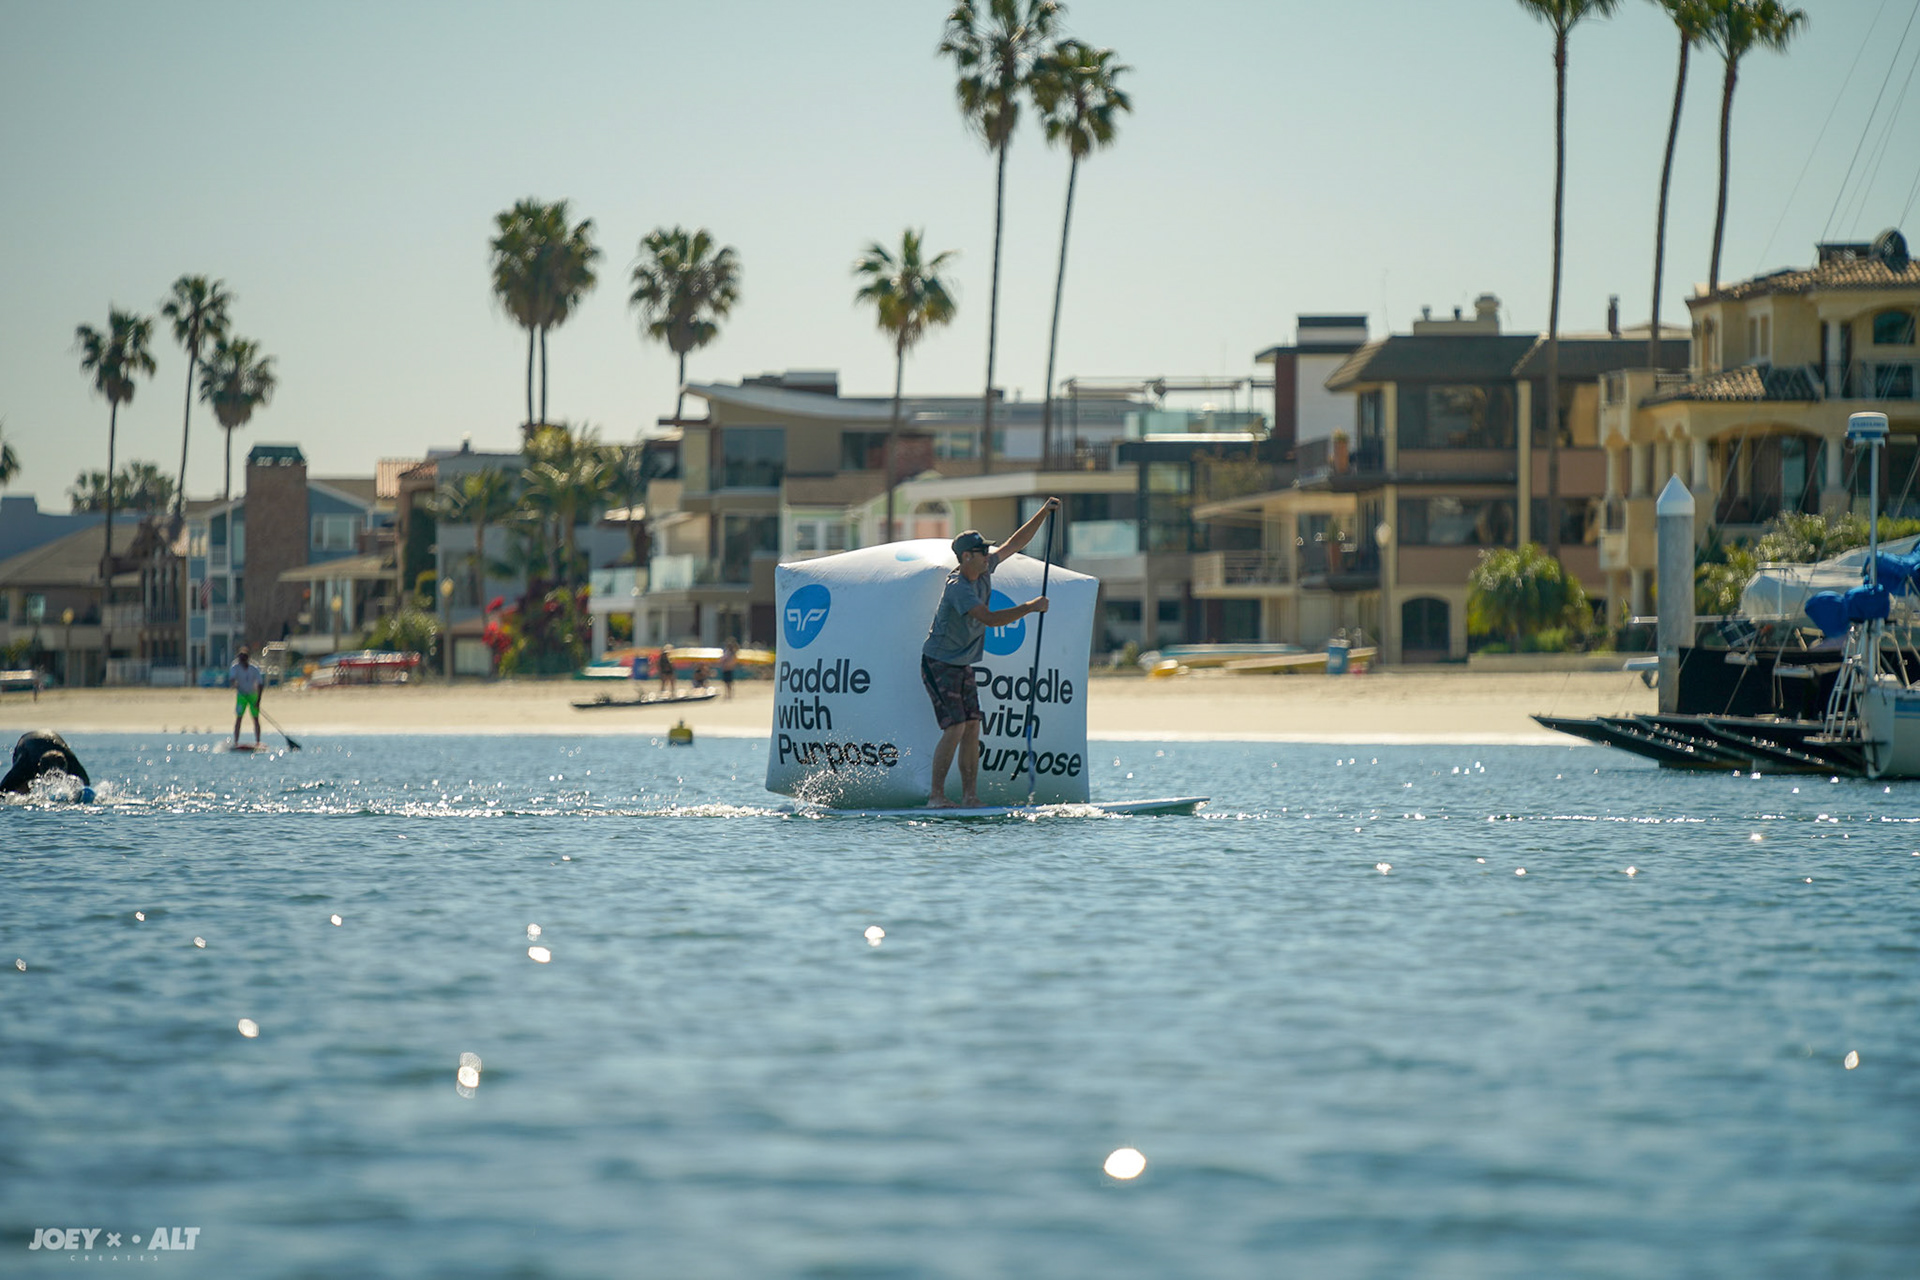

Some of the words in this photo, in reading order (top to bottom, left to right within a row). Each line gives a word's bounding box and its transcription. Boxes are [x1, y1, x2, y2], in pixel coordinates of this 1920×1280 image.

[779, 658, 871, 694] Paddle
[971, 666, 1073, 704] Paddle
[778, 695, 832, 730] with
[778, 733, 898, 773] Purpose
